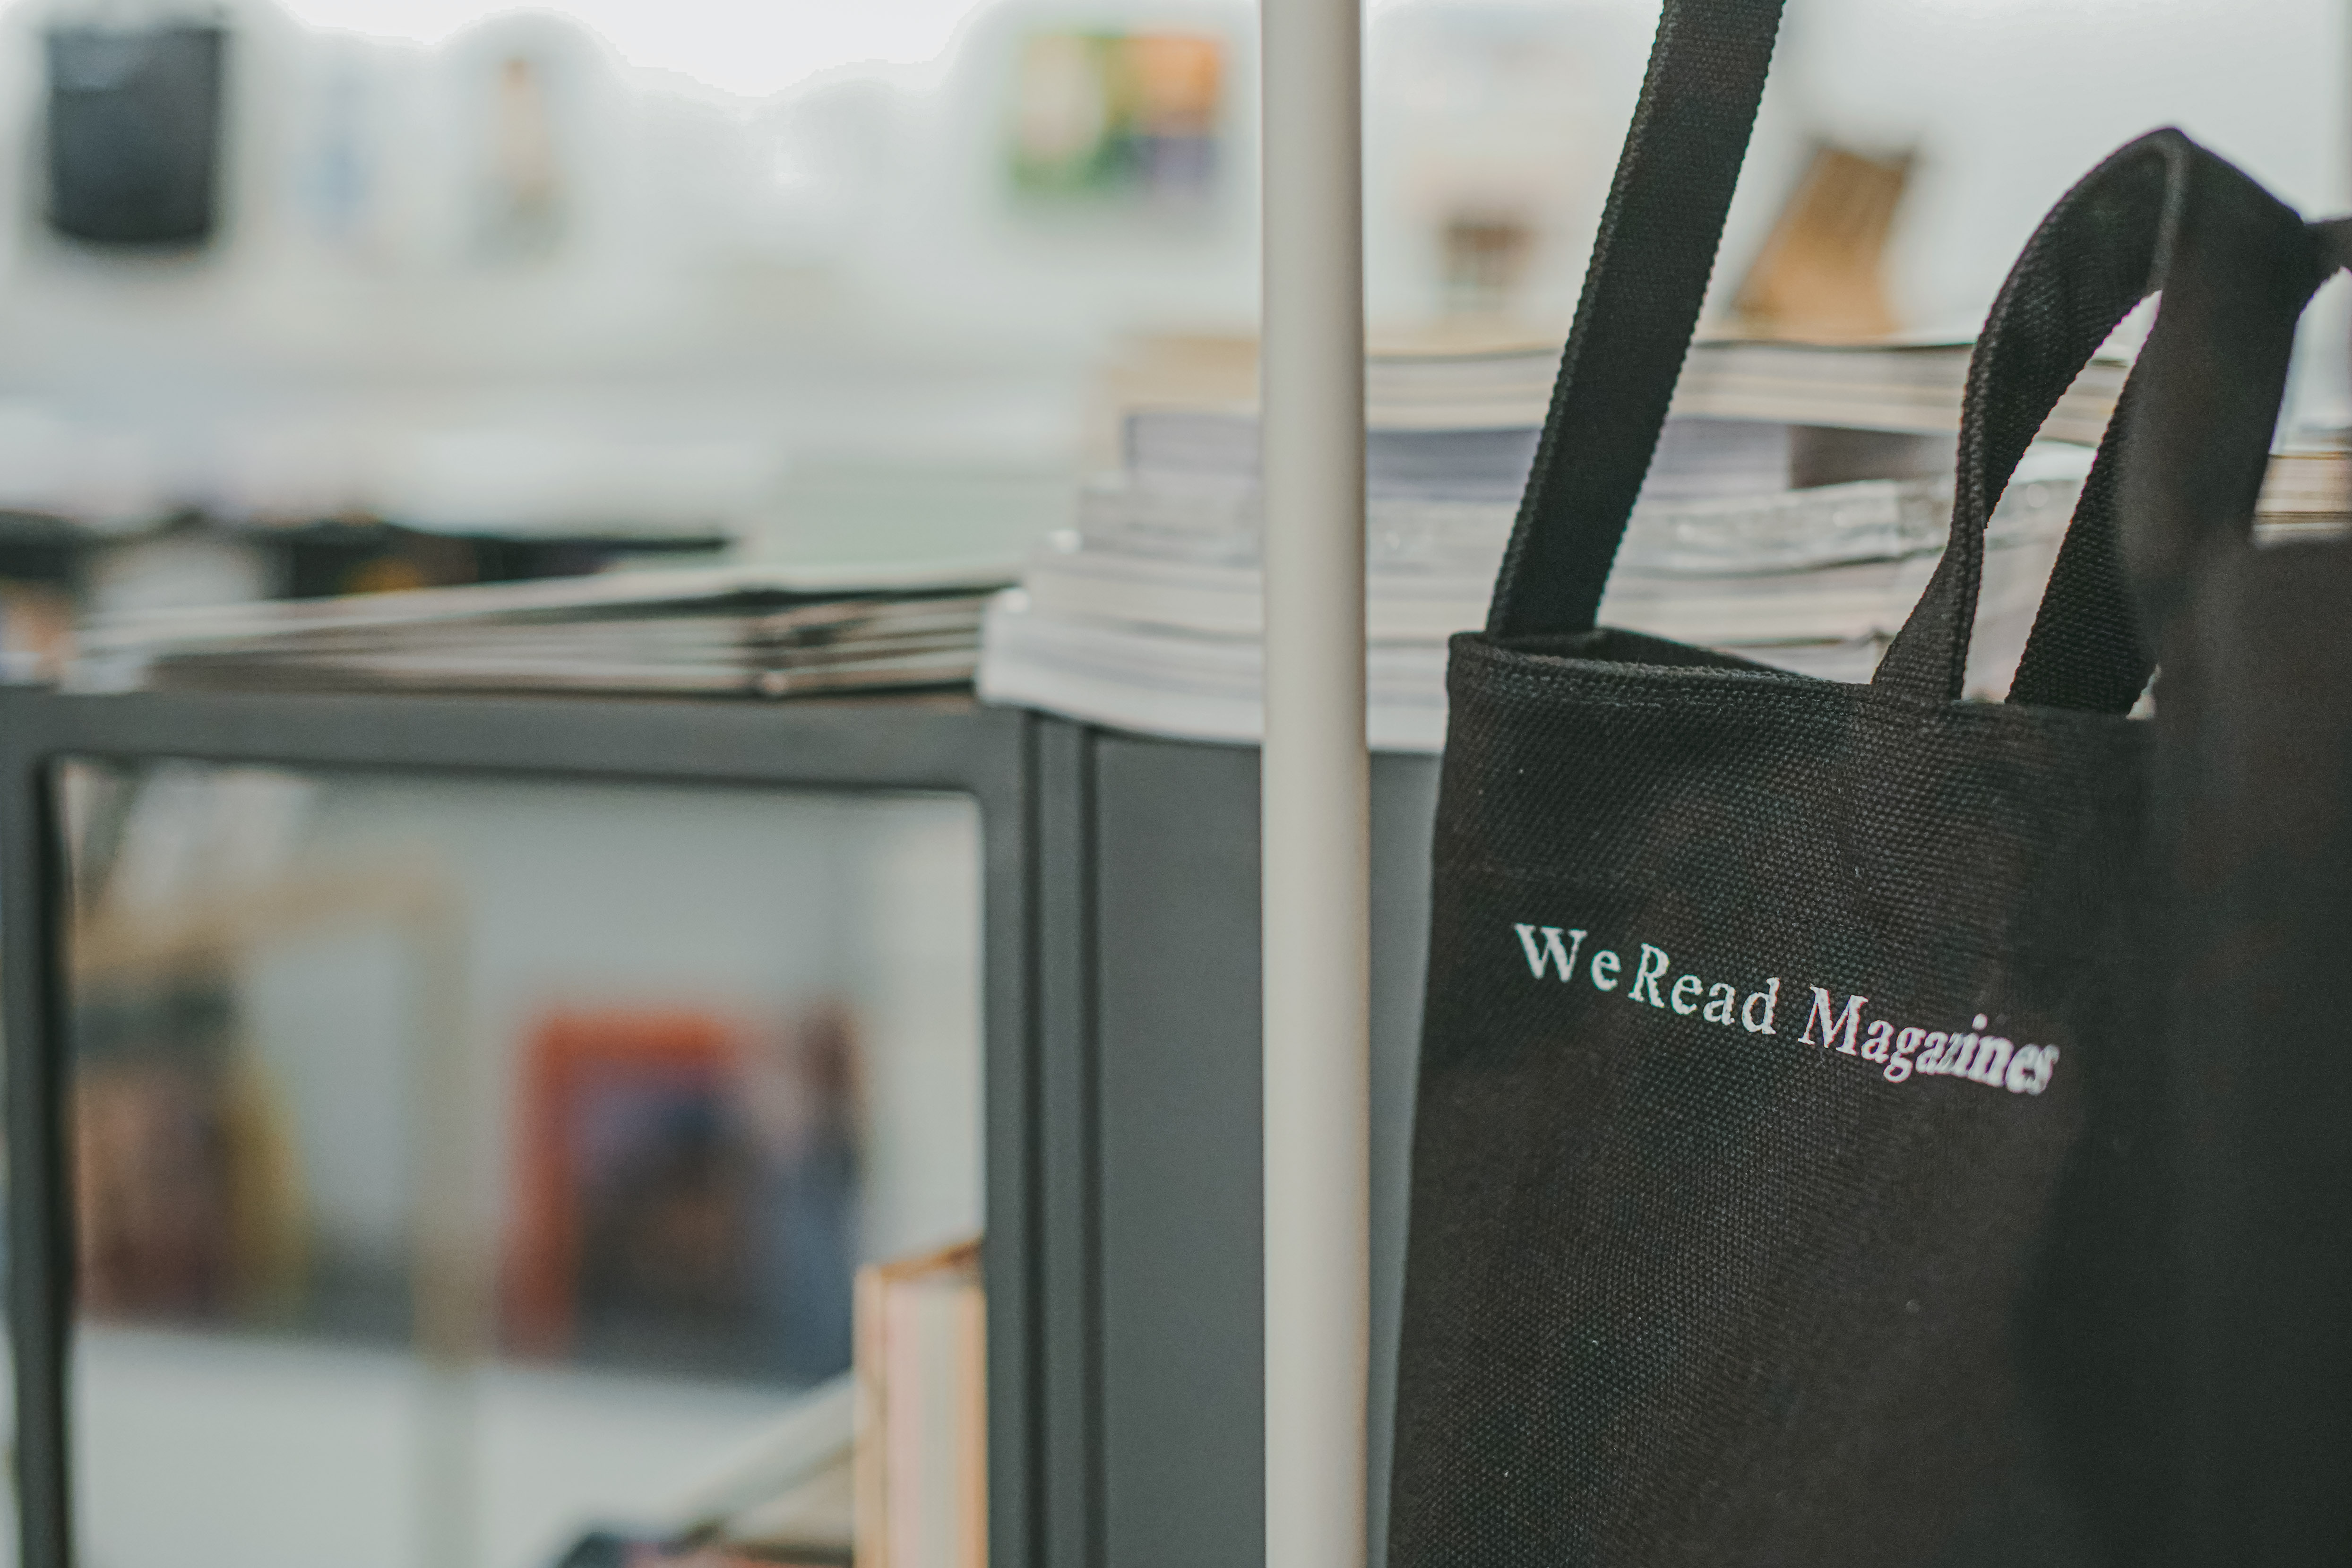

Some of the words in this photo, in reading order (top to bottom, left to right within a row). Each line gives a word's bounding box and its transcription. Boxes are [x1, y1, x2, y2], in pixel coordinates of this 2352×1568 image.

[1513, 923, 1621, 992] We
[1627, 942, 1781, 1035] Read
[1796, 982, 2060, 1095] Magazines
